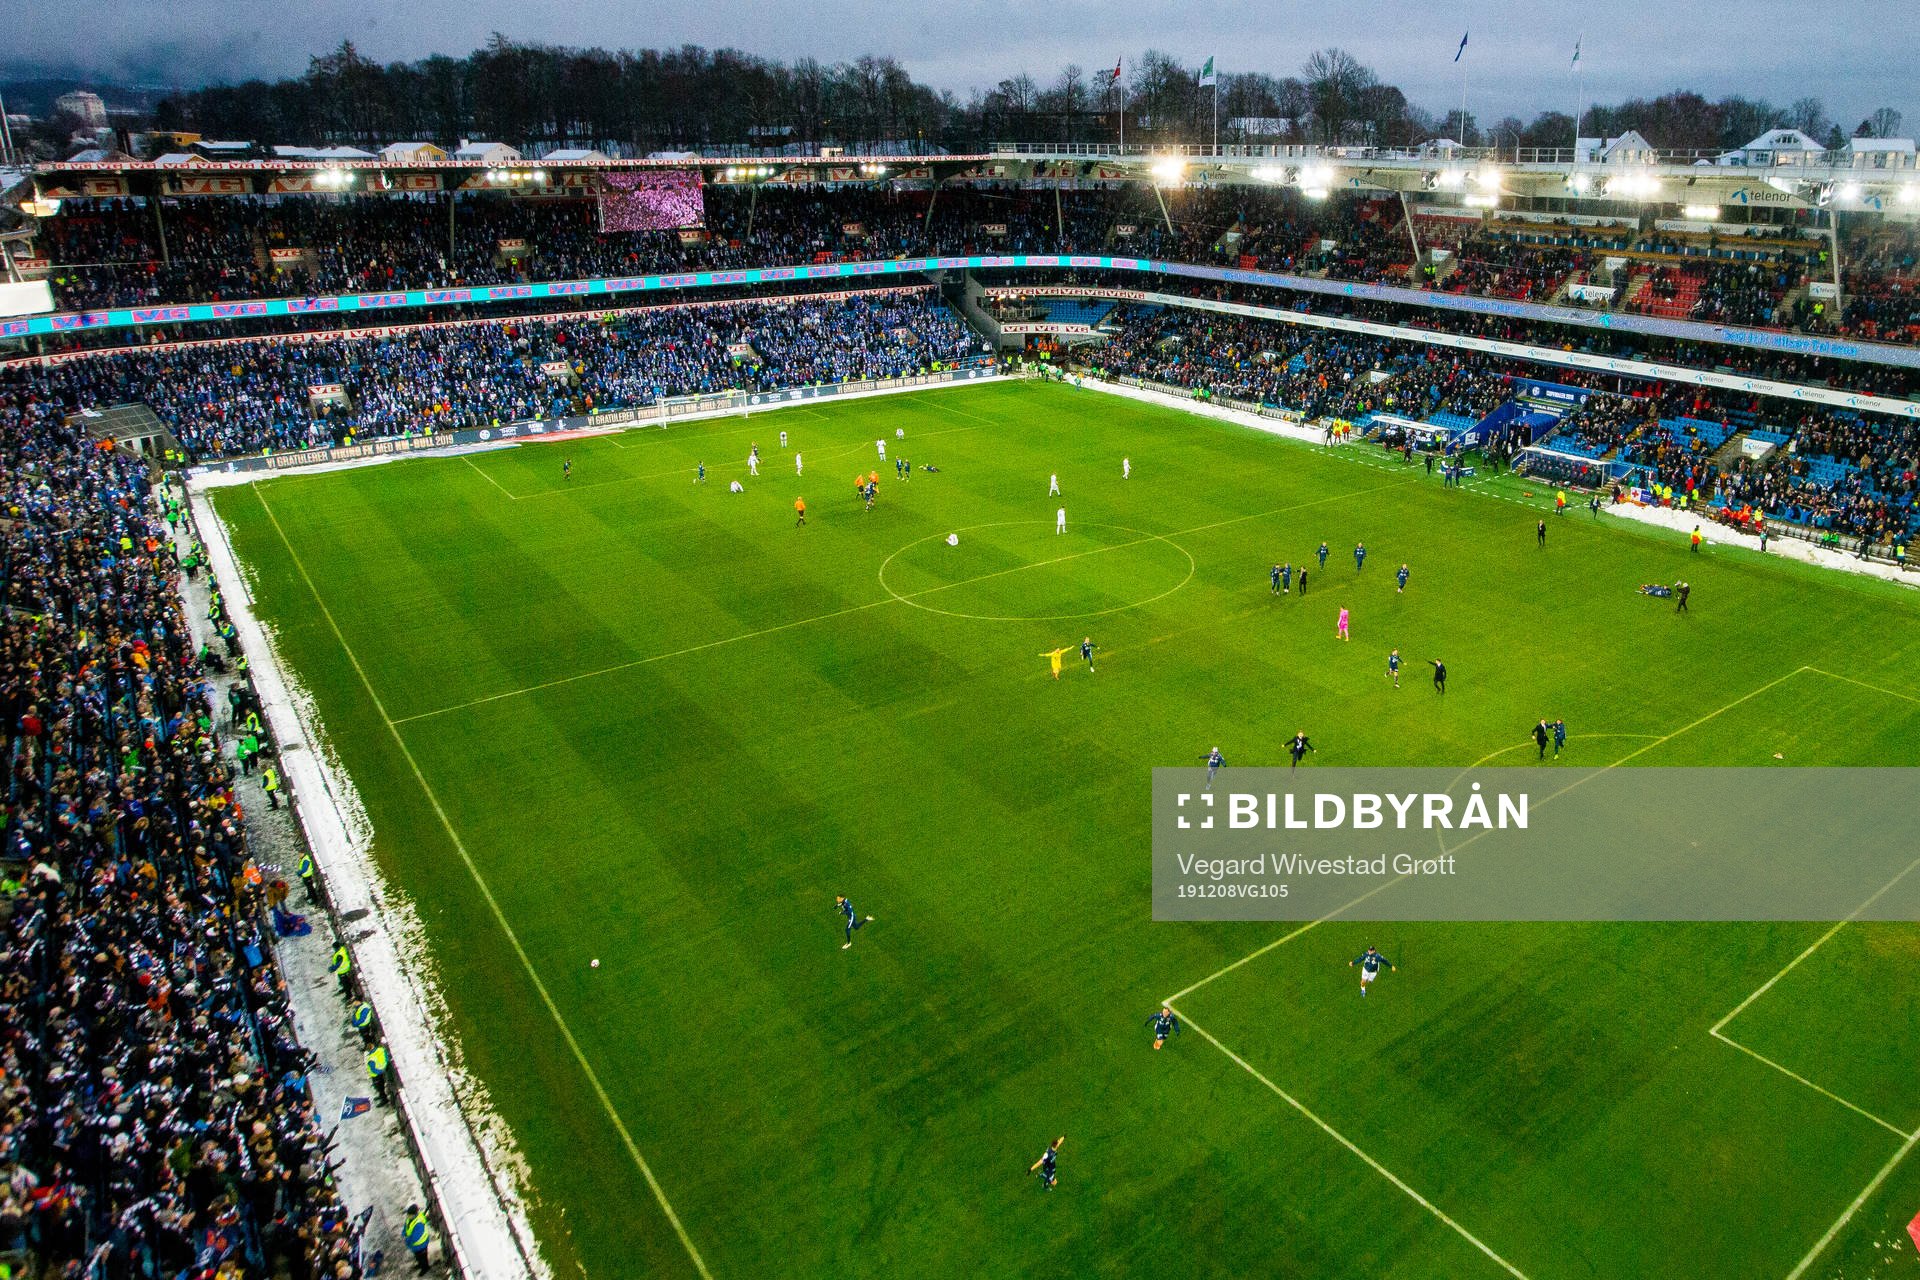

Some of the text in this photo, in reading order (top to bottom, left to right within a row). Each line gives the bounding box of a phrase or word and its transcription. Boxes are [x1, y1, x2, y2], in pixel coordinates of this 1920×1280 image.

[1750, 190, 1791, 202] telenor
[985, 288, 1010, 296] VG
[1036, 287, 1059, 295] VG
[1585, 290, 1612, 299] telenor
[133, 308, 189, 322] VG
[213, 304, 266, 317] VG
[360, 295, 406, 307] VG
[427, 290, 471, 302] VG
[490, 286, 532, 298] VG
[308, 385, 342, 394] VG
[1614, 361, 1634, 369] telenor
[1657, 368, 1678, 377] telenor
[1703, 374, 1724, 383] telenor
[1752, 382, 1773, 391] telenor
[1803, 389, 1826, 399] telenor
[1857, 397, 1881, 407] telenor
[587, 415, 595, 426] VI
[596, 411, 634, 425] GRATULERER
[266, 457, 276, 469] VI
[277, 451, 328, 468] GRATULERER
[330, 447, 361, 460] VIKING
[362, 445, 374, 456] FK
[375, 442, 394, 454] MED
[435, 434, 454, 446] 2019
